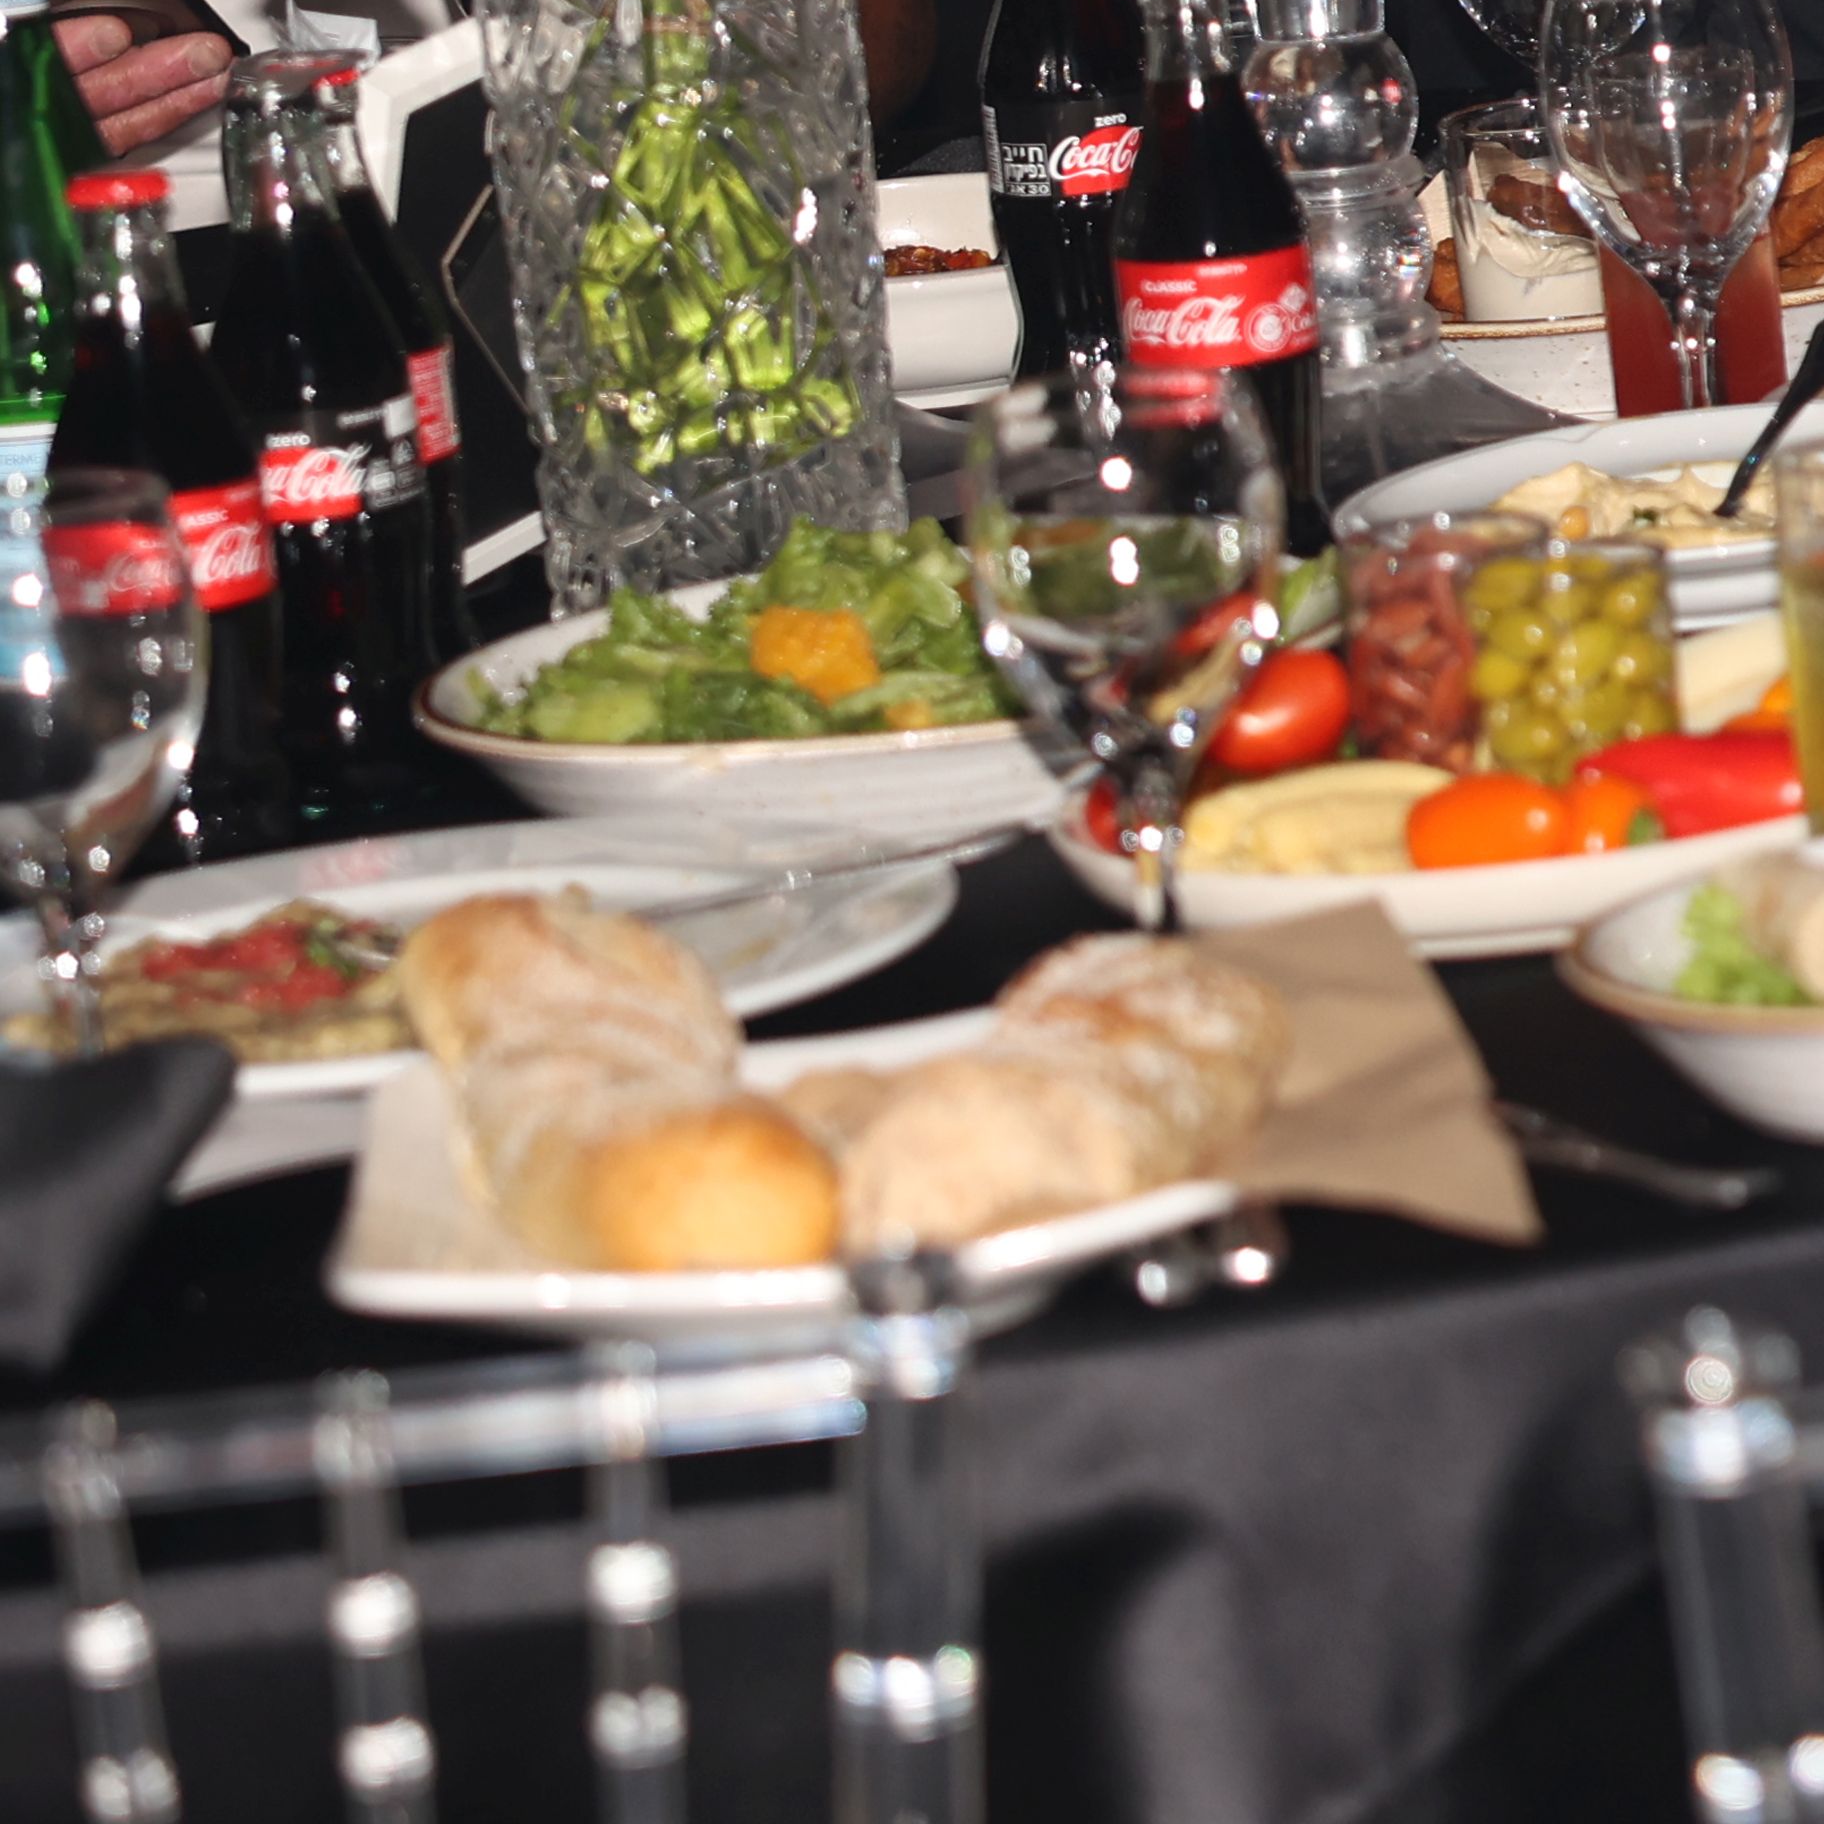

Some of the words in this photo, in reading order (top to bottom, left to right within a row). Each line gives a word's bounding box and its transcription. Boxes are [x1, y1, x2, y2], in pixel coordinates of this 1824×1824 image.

[1094, 113, 1127, 127] zero
[1002, 146, 1044, 163] חייב
[1049, 126, 1144, 180] Coca-C
[1028, 184, 1049, 194] 30
[1142, 280, 1198, 294] CLASSIC
[1123, 295, 1246, 347] Coca-Cola
[266, 432, 311, 448] zero
